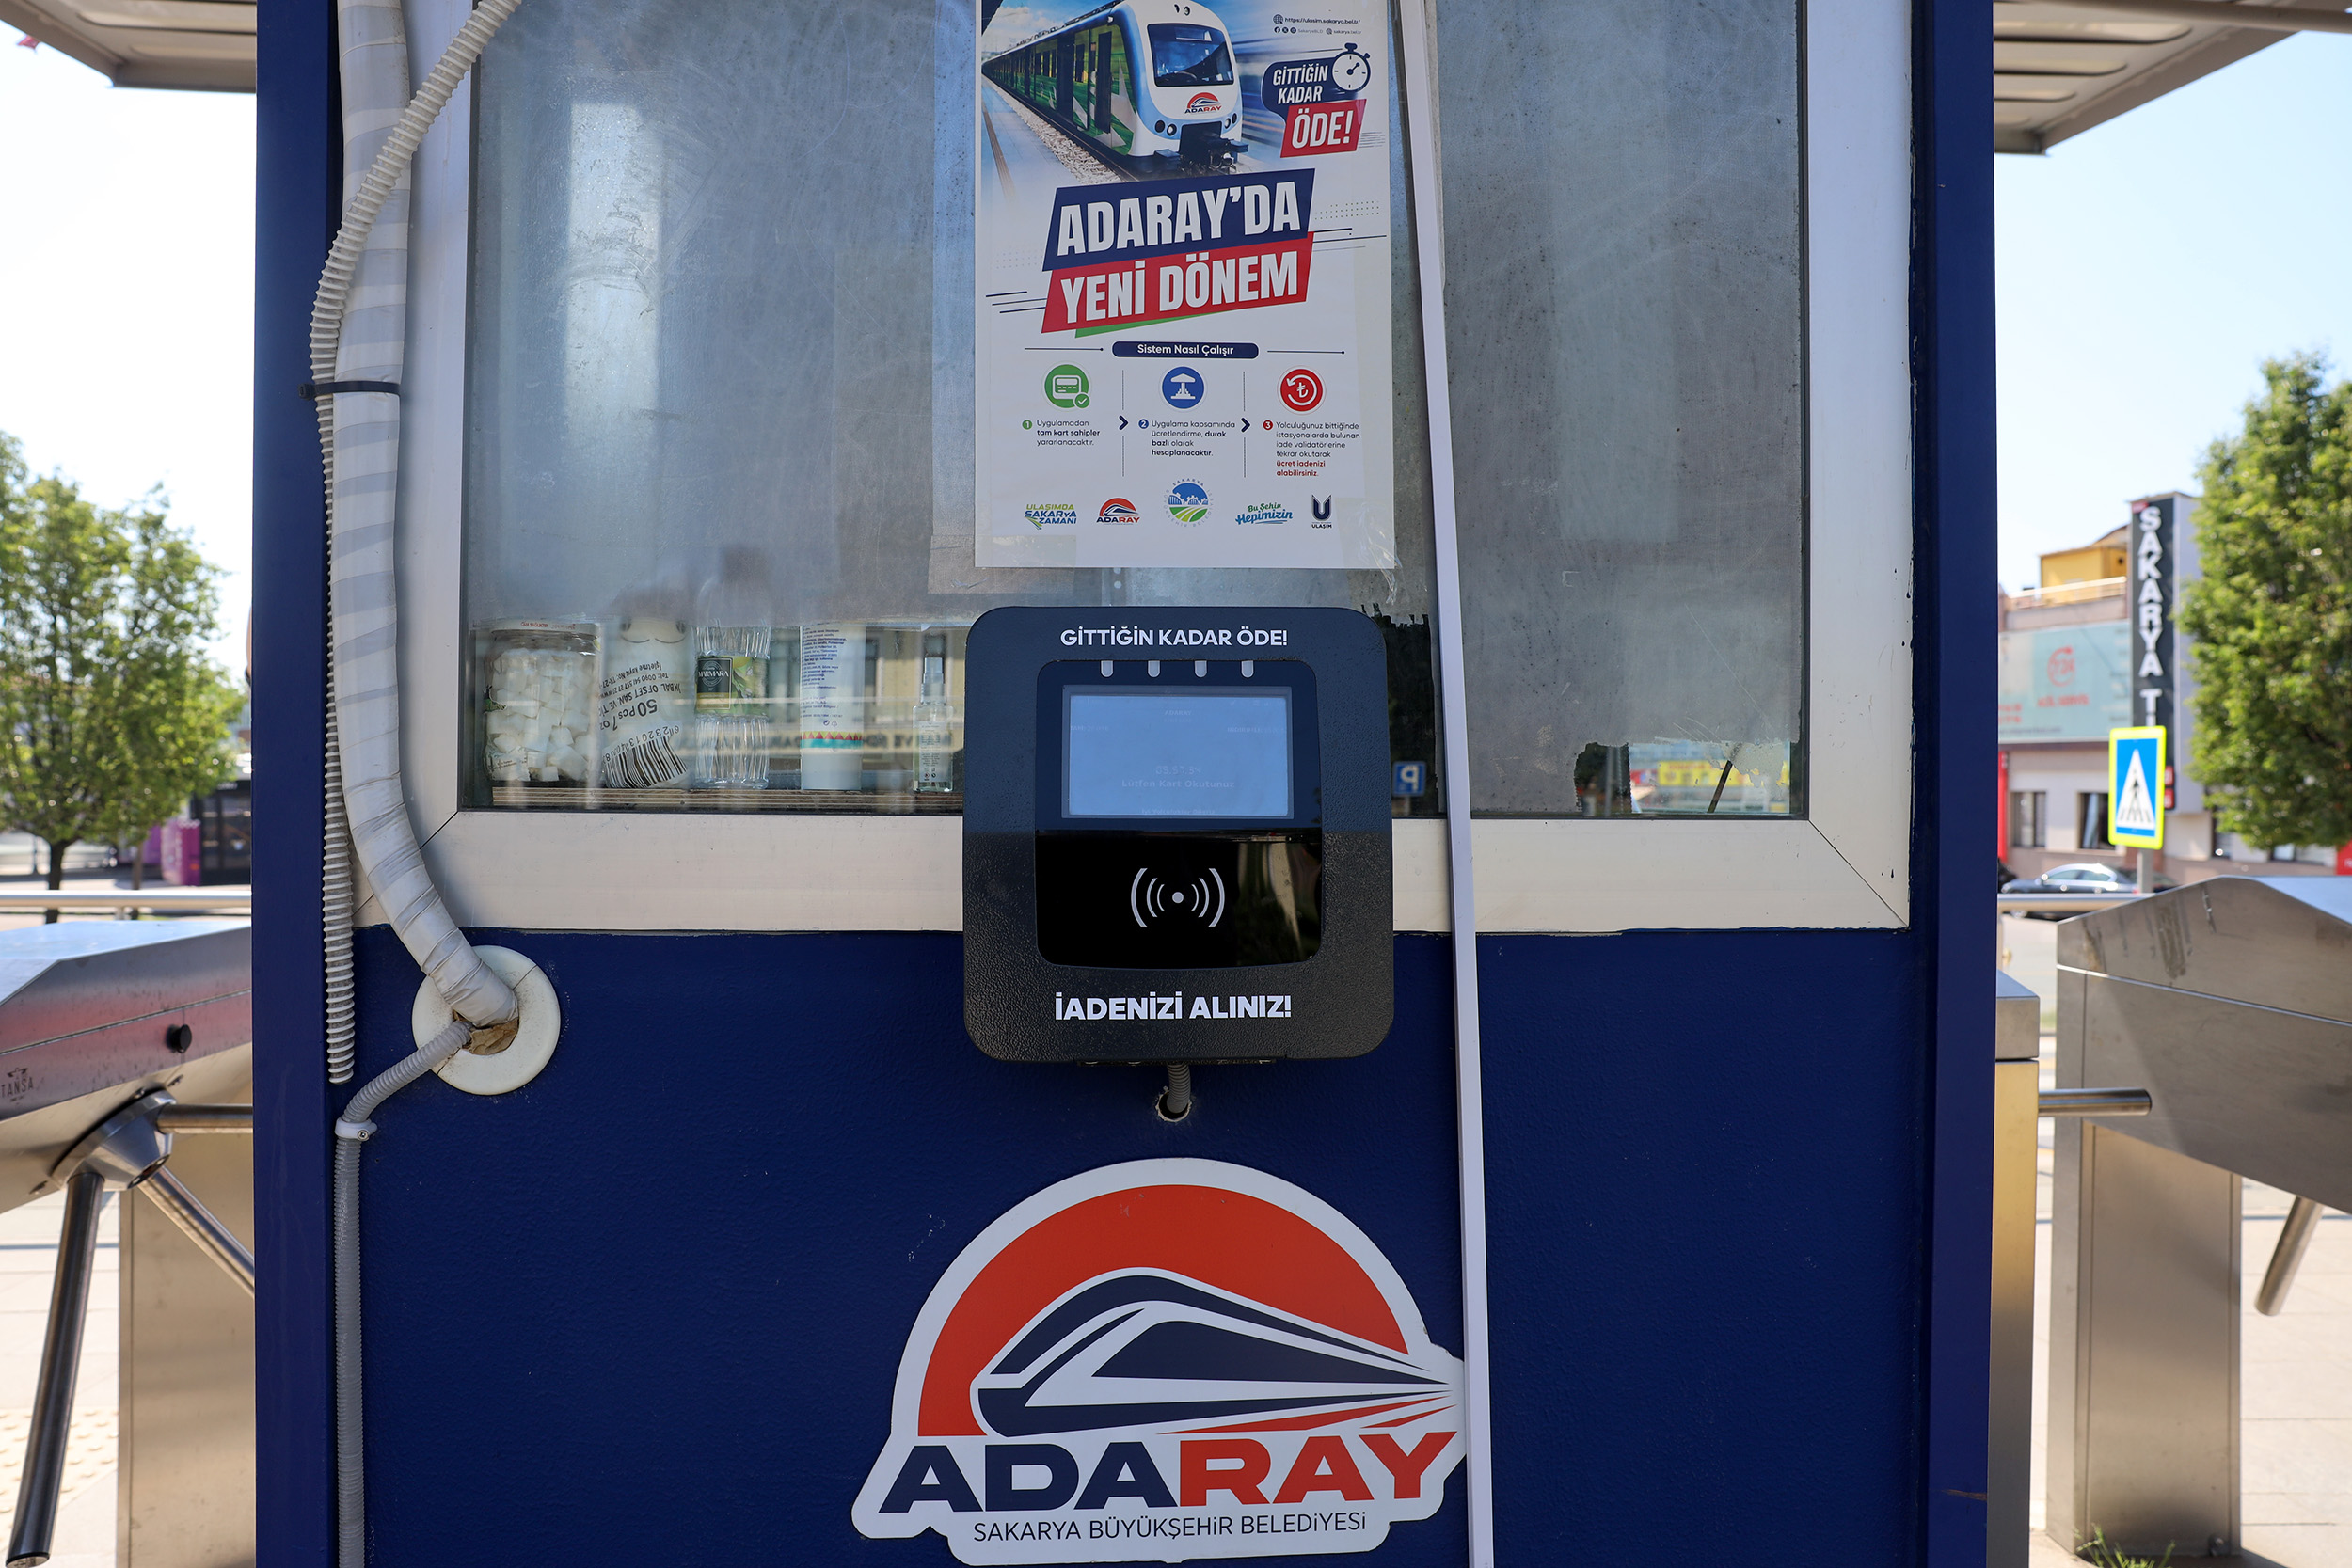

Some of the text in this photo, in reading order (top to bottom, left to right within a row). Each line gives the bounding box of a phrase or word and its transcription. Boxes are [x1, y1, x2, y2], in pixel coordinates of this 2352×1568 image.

[1273, 63, 1328, 86] GİTTİĞİN
[1278, 86, 1323, 104] KADAR
[1184, 105, 1222, 114] ADARAY
[1292, 108, 1354, 149] ÖDE!
[1060, 251, 1298, 324] YENİ DÖNEM
[1137, 344, 1233, 356] Sistem Nasıl Çalışır
[1037, 420, 1089, 428] Uygulamadan
[1152, 420, 1188, 429] Uygulama
[1276, 421, 1359, 431] Yolculuğunuz bittiğinde
[1152, 430, 1203, 438] ücretlendirme,
[1152, 449, 1213, 457] hesaplanacaktır.
[1235, 509, 1293, 525] Hepimizin
[2138, 506, 2163, 676] SAKARYA
[1060, 626, 1288, 646] GİTTİĞİN KADAR ÖDE!
[617, 692, 633, 705] SAN.
[634, 685, 659, 699] OFSET
[609, 702, 618, 711] VE
[618, 705, 636, 720] Pcs
[637, 699, 658, 717] 50
[1121, 779, 1235, 788] Lütfen Kart Okutunuz
[1055, 990, 1292, 1021] İADENİZİ ALINIZ!
[1, 1077, 34, 1098] TANSA
[878, 1431, 1458, 1513] ADARAY
[973, 1512, 1367, 1543] SAKARYA BÜYÜKŞEHİR BELEDİYESİ
